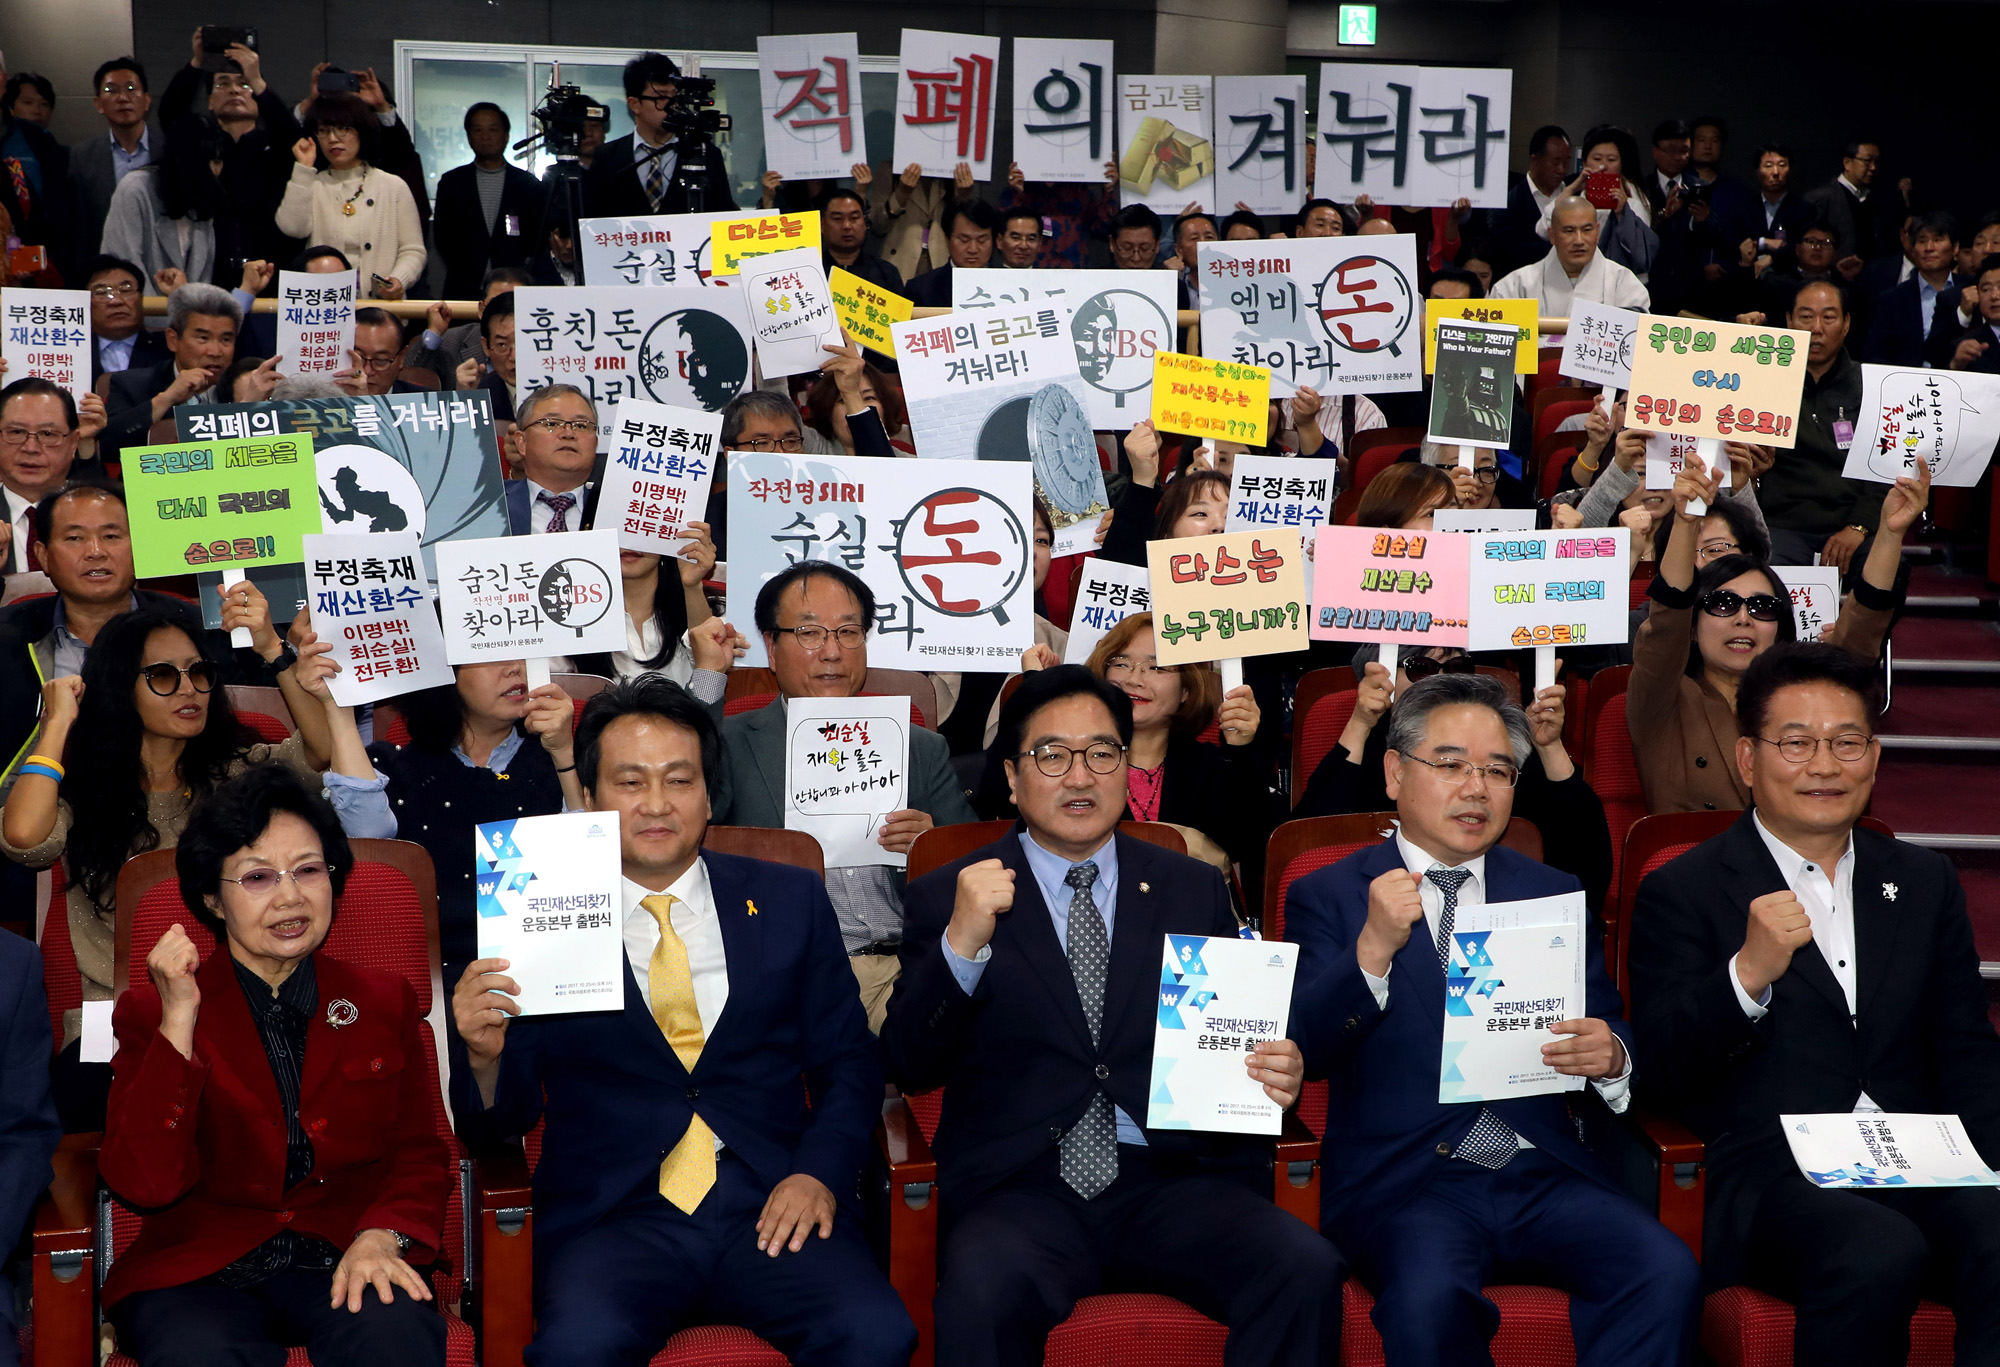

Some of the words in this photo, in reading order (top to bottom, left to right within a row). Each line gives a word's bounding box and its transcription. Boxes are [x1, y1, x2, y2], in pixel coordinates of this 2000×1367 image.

[1124, 83, 1205, 112] 금고를
[594, 232, 638, 247] 작전명
[641, 231, 671, 243] SIRI
[728, 216, 803, 241] 다스는
[612, 250, 677, 284] 순실
[1208, 257, 1255, 279] 작전명
[1257, 257, 1291, 275] SIRI
[285, 285, 352, 306] 부정축재
[1230, 281, 1298, 326] 엠비
[1322, 257, 1395, 350] 돈
[8, 305, 85, 325] 부정축재
[285, 305, 352, 325] 재산환수
[865, 304, 900, 328] 찾으
[9, 327, 86, 347] 재산환수
[300, 330, 341, 344] 이명박!
[904, 322, 980, 358] 적폐의
[986, 308, 1060, 346] 금고를
[1441, 329, 1467, 341] 다스는
[1467, 332, 1484, 342] 누구
[1484, 333, 1515, 346] 것인가?
[1649, 324, 1716, 353] 국민의
[1730, 333, 1796, 367] 세금을
[27, 353, 73, 367] 이명박!
[299, 345, 340, 358] 최순실!
[1442, 343, 1457, 351] Who
[1458, 344, 1465, 352] Is
[1484, 347, 1511, 356] Father?
[1574, 343, 1618, 368] 찾아라
[299, 359, 339, 373] 전두환!
[541, 355, 586, 373] 작전명
[594, 356, 626, 370] SIRI
[944, 350, 1030, 386] 겨눠라!
[1692, 370, 1741, 393] 다시
[189, 409, 281, 441] 적폐의
[290, 404, 382, 438] 금고를
[392, 398, 491, 441] 겨눠라!
[1634, 394, 1701, 425] 국민의
[1716, 404, 1792, 438] 손으로!!
[621, 419, 713, 457] 부정축재
[140, 449, 213, 475] 국민의
[225, 441, 298, 468] 세금을
[617, 446, 708, 482] 재산환수
[632, 480, 687, 504] 이명박!
[748, 477, 816, 505] 작전명
[819, 482, 865, 502] SIRI
[1239, 475, 1327, 501] 부정축재
[157, 496, 207, 520] 다시
[218, 488, 292, 514] 국민의
[628, 499, 684, 524] 최순실!
[1235, 501, 1324, 527] 재산환수
[624, 517, 679, 541] 전두환!
[184, 535, 276, 566] 손으로!!
[770, 511, 867, 571] 순실
[901, 491, 1003, 613] 돈
[1371, 533, 1428, 561] 최순실
[1484, 539, 1547, 562] 국민의
[1555, 537, 1617, 559] 세금을
[313, 556, 417, 586] 부정축재
[1170, 539, 1284, 586] 다스는
[1360, 568, 1433, 594] 재산몰수
[1494, 583, 1536, 605] 다시
[1544, 580, 1606, 602] 국민의
[317, 585, 423, 618] 재산환수
[473, 594, 503, 607] 작전명
[508, 593, 530, 603] SIRI
[1086, 579, 1150, 611] 부정축
[343, 619, 411, 641] 이명박!
[462, 604, 544, 639] 찾아라
[1161, 601, 1300, 645] 누구겁니까?
[1511, 624, 1587, 647] 손으로!!
[349, 638, 417, 660] 최순실!
[918, 645, 984, 656] 국민재산되찾기
[986, 646, 1023, 657] 운동본부
[353, 657, 420, 683] 전두환!
[854, 748, 883, 773] 몰수
[527, 893, 611, 913] 국민재산되찾기
[522, 915, 573, 932] 운동본부
[576, 912, 612, 930] 출범식
[1492, 997, 1565, 1015] 국민재산되찾기
[1205, 1017, 1278, 1035] 국민재산되찾기
[1486, 1017, 1531, 1032] 운동본부
[1197, 1035, 1241, 1051] 운동본부
[1856, 1120, 1890, 1168] 국민재산되찾기
[1873, 1120, 1895, 1144] 출범식
[1886, 1145, 1912, 1170] 운동본부
